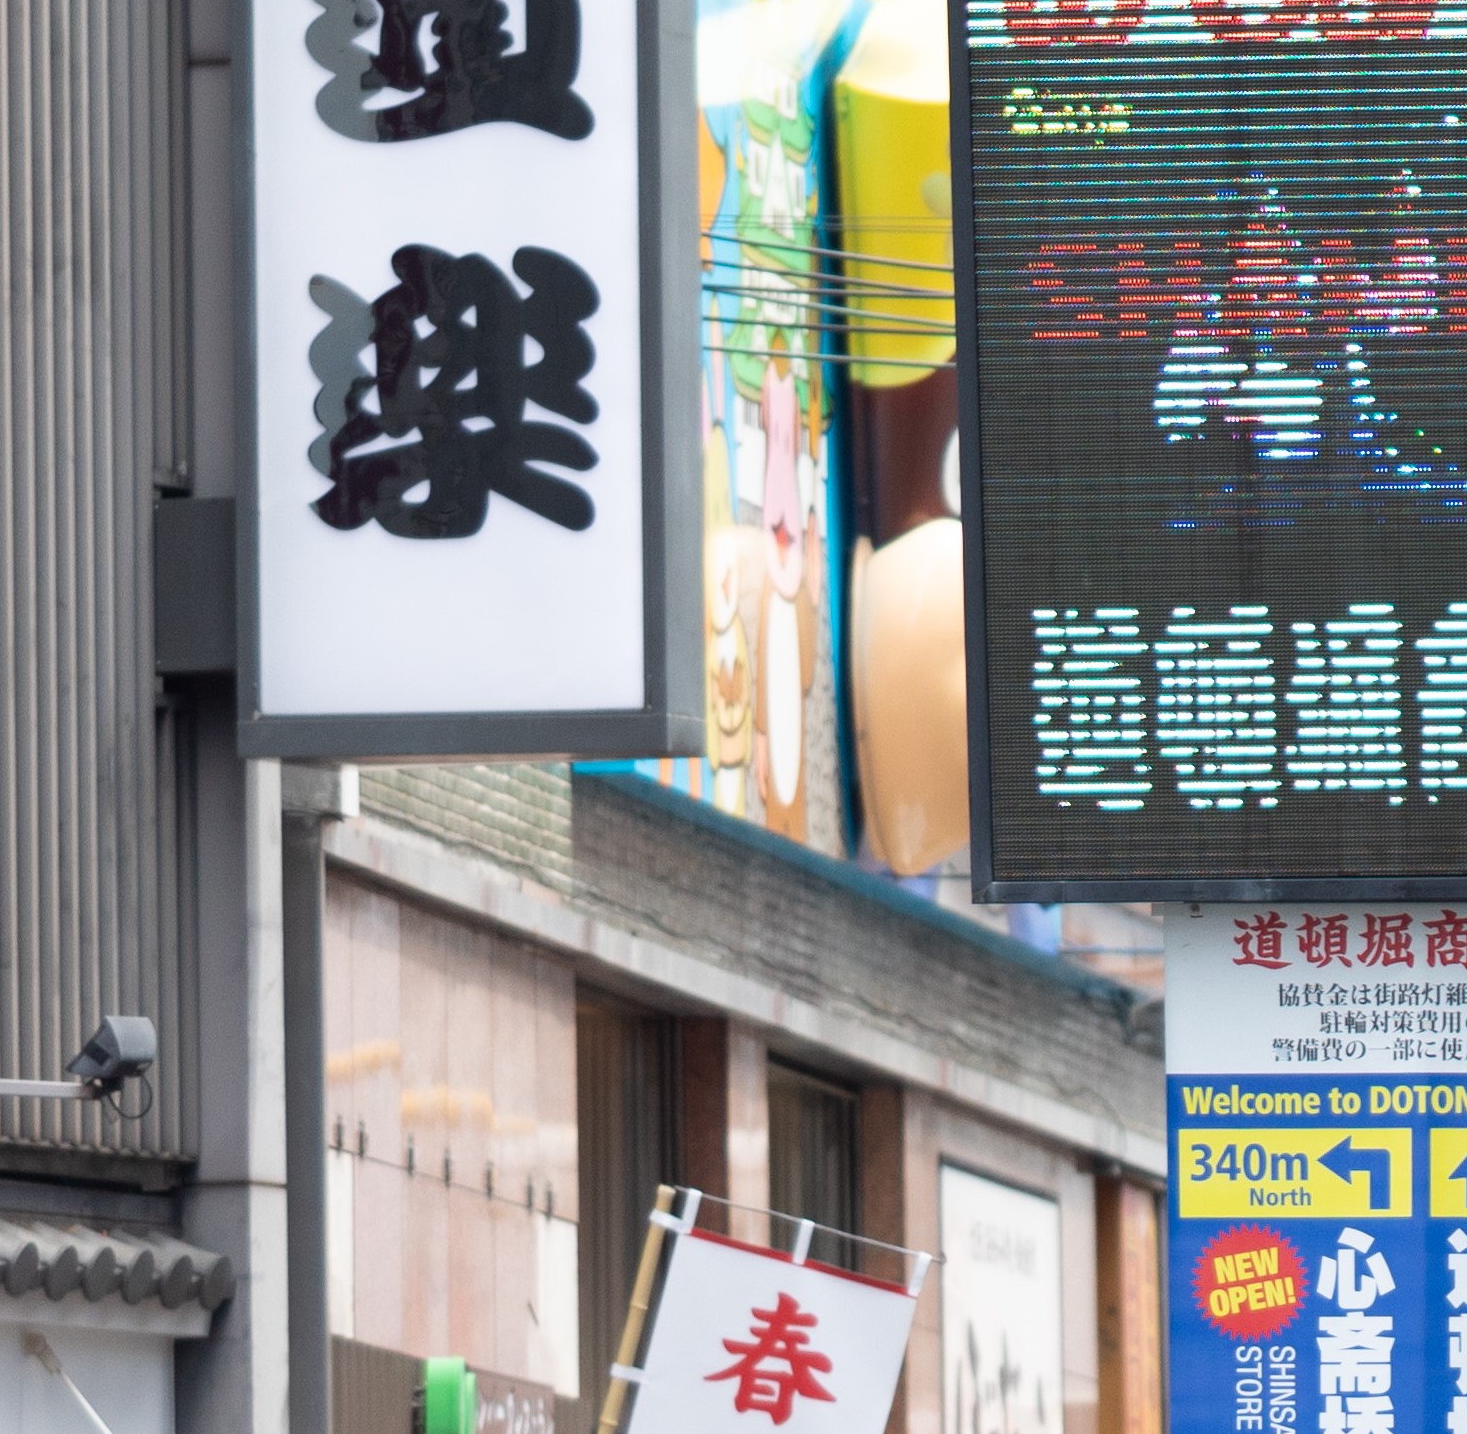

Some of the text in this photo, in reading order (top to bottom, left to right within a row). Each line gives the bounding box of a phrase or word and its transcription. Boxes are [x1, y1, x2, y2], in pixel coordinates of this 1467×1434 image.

[1183, 1085, 1321, 1117] Welcome
[1328, 1087, 1362, 1116] to
[1189, 1142, 1310, 1183] 340m
[1248, 1186, 1313, 1208] North
[1213, 1247, 1280, 1282] NEW
[1208, 1277, 1297, 1319] OPEN!
[1234, 1345, 1263, 1431] STORE
